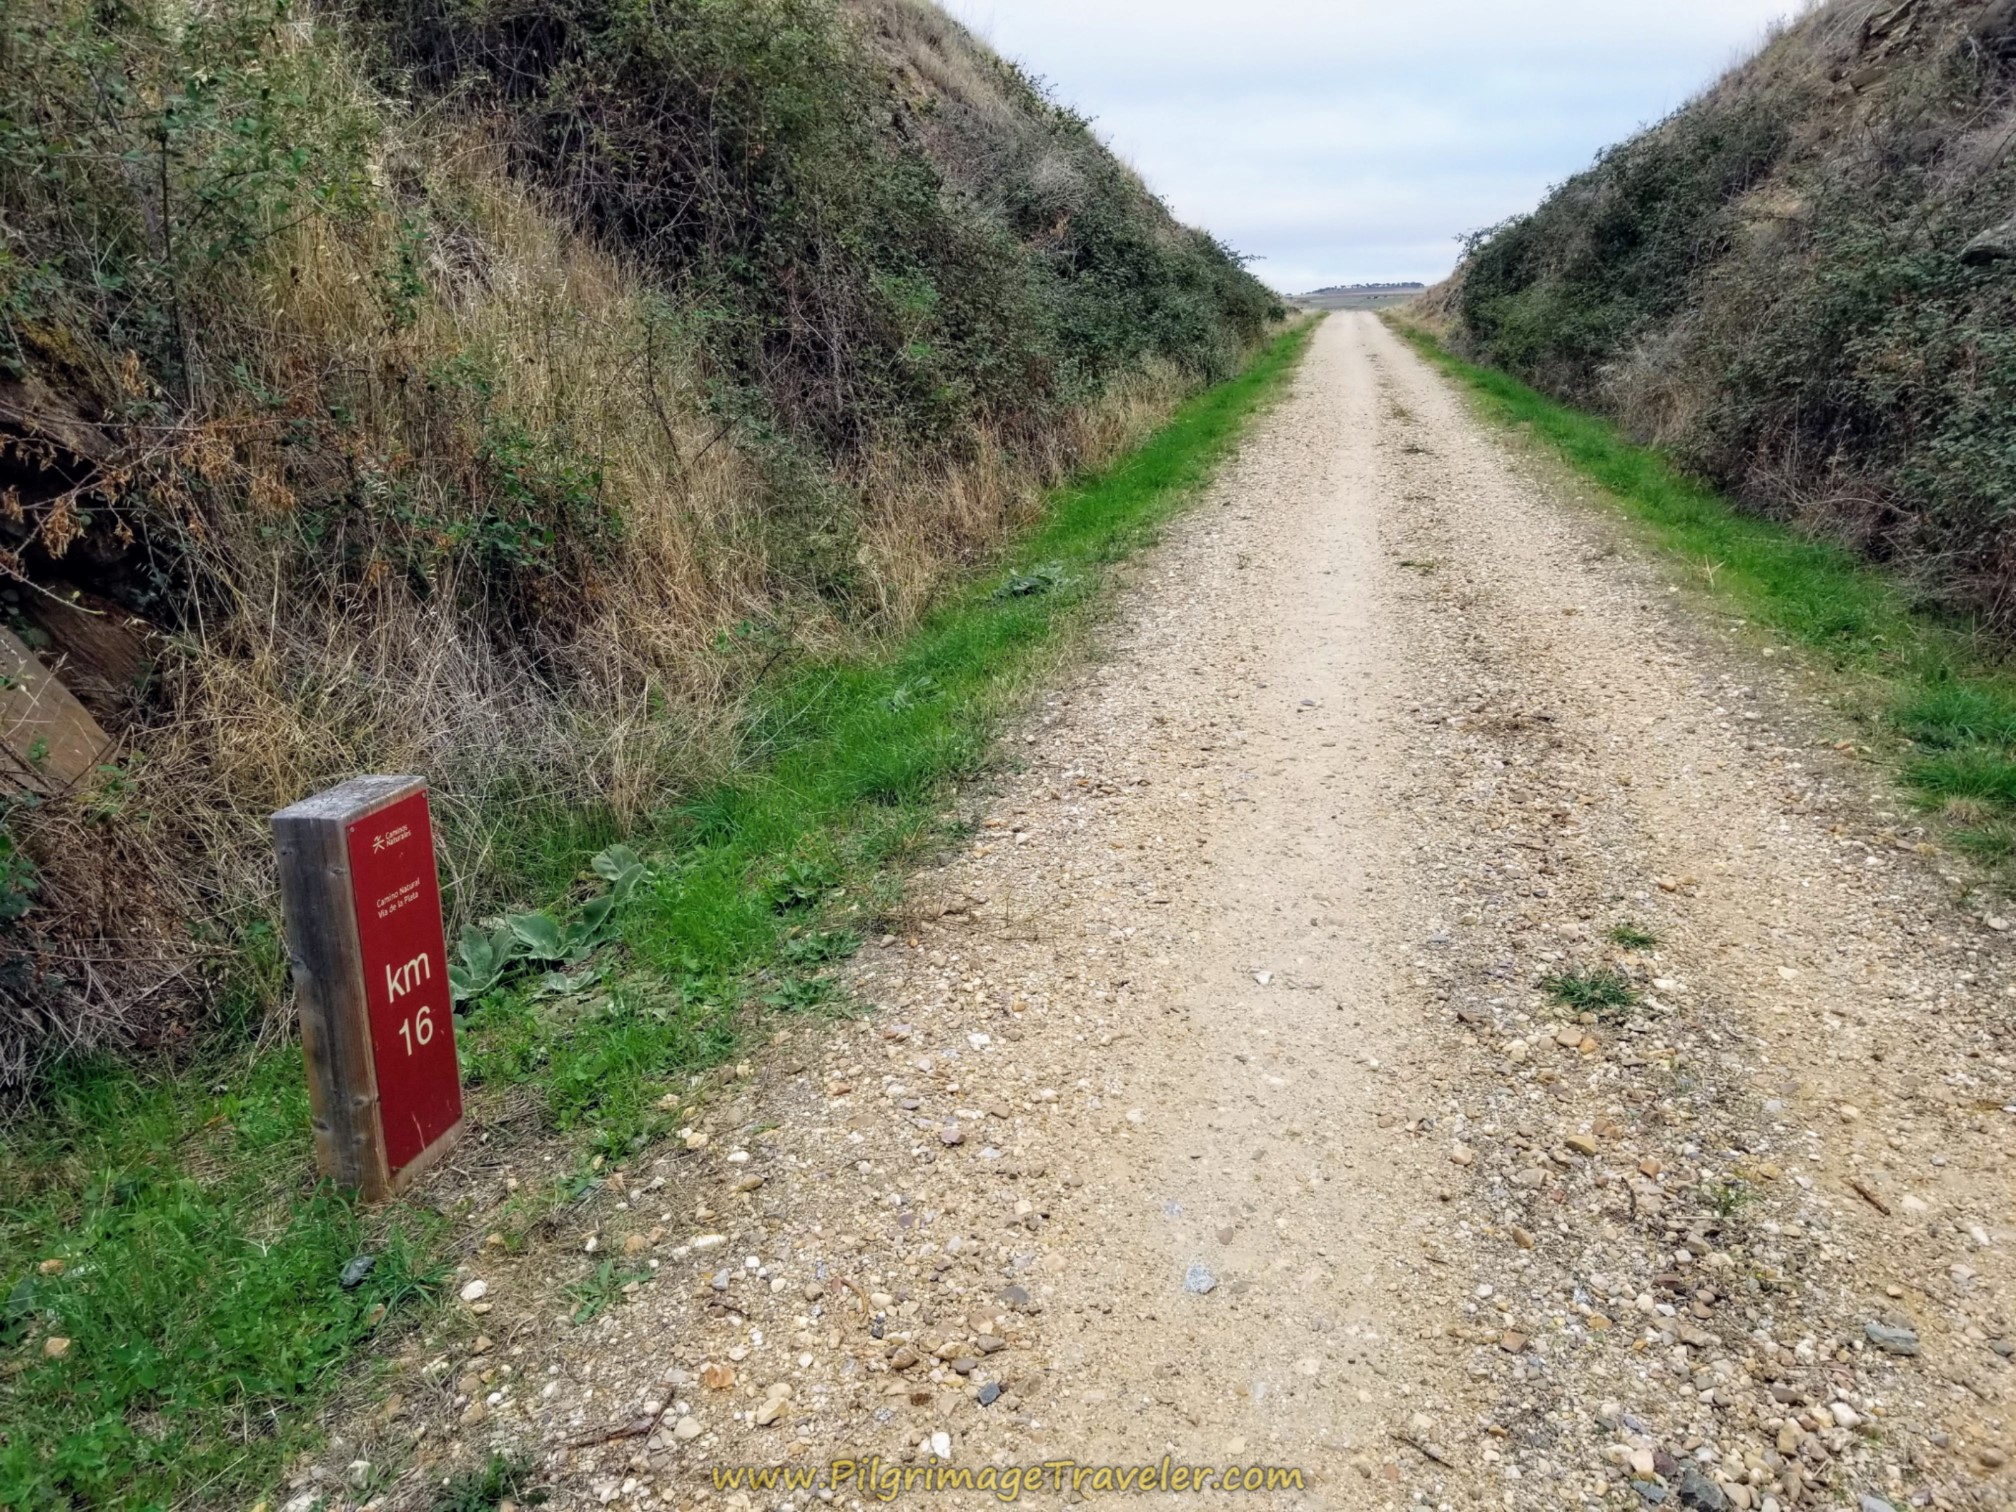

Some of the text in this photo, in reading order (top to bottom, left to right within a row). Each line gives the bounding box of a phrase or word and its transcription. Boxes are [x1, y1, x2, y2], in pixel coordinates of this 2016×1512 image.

[385, 824, 408, 840] Caminos
[376, 877, 420, 908] Camino Natural
[389, 903, 396, 913] de
[397, 900, 403, 908] la
[404, 891, 418, 904] Plata
[386, 952, 431, 1004] km
[398, 1005, 433, 1056] 16
